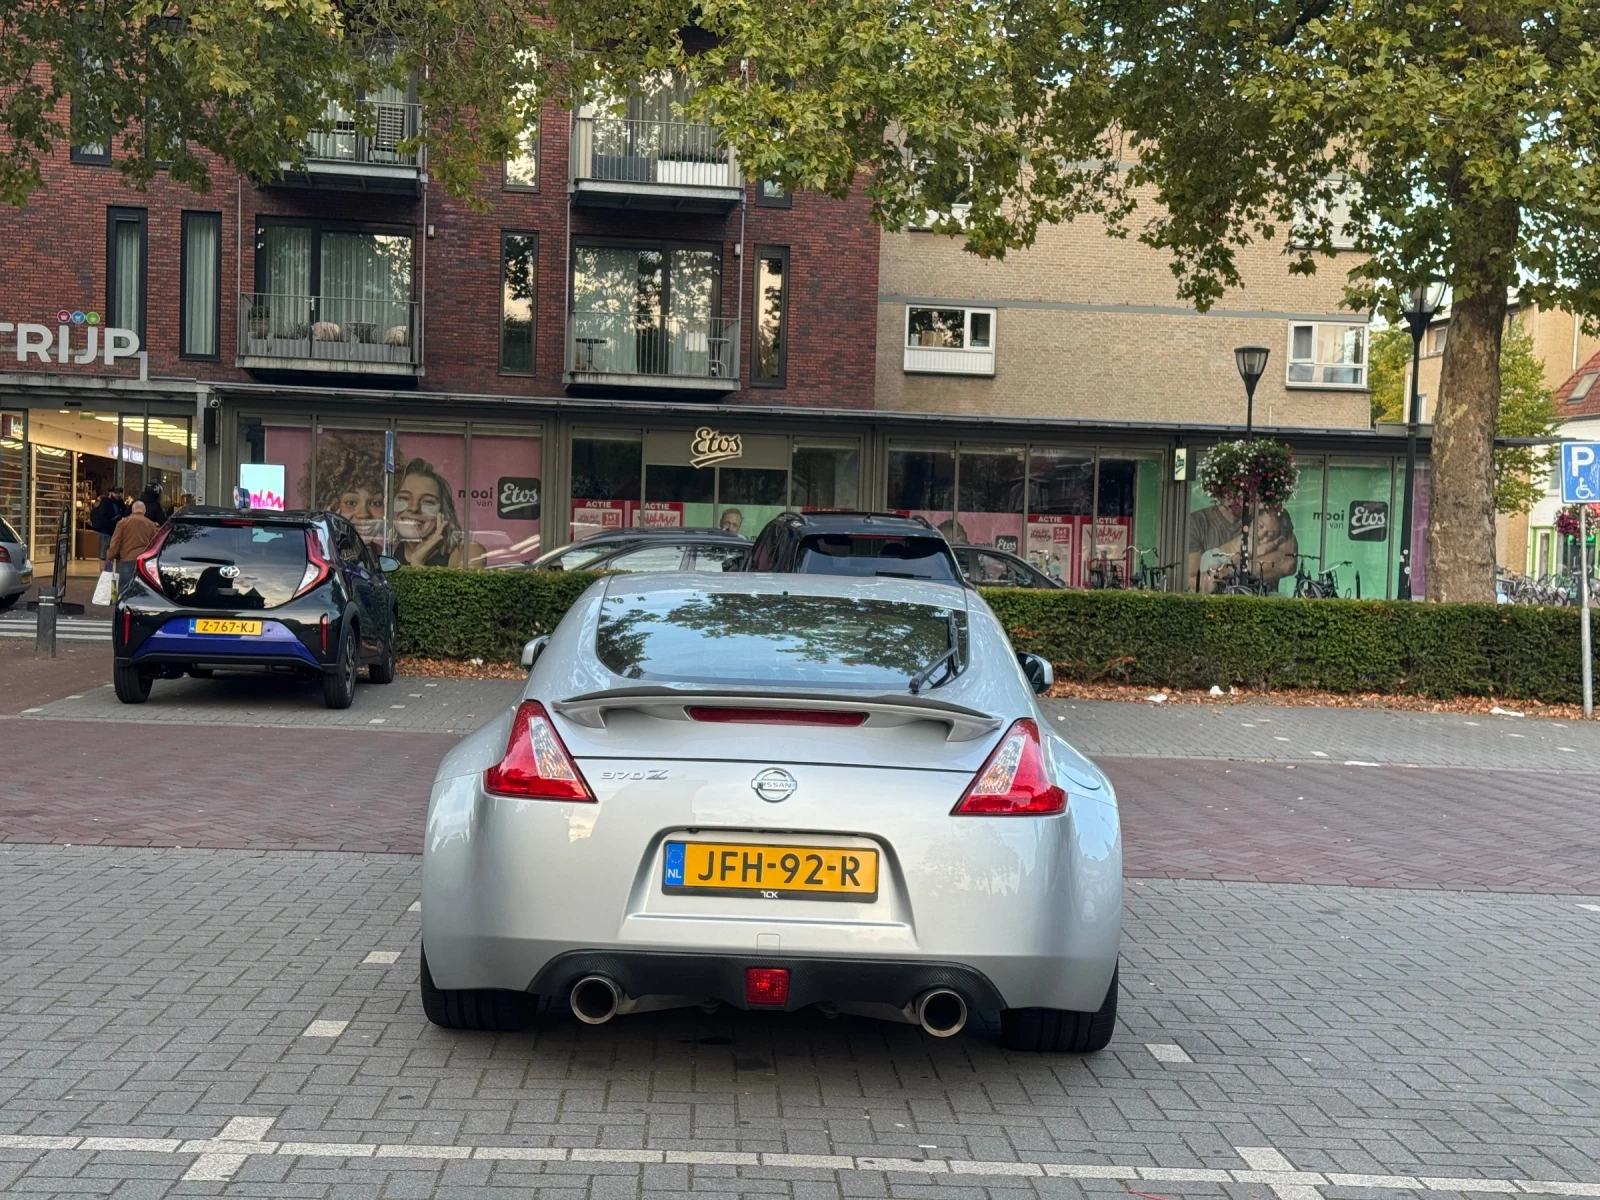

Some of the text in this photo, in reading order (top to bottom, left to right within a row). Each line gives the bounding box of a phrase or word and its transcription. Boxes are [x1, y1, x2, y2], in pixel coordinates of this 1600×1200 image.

[691, 427, 742, 458] Etos
[1571, 446, 1595, 477] P
[500, 483, 538, 506] Etos
[1313, 510, 1344, 521] mooi
[1351, 506, 1386, 527] Etos
[997, 539, 1016, 550] Etos
[202, 621, 255, 633] Z-767-KJ
[667, 868, 682, 879] NL
[698, 850, 861, 887] JFH-92-R
